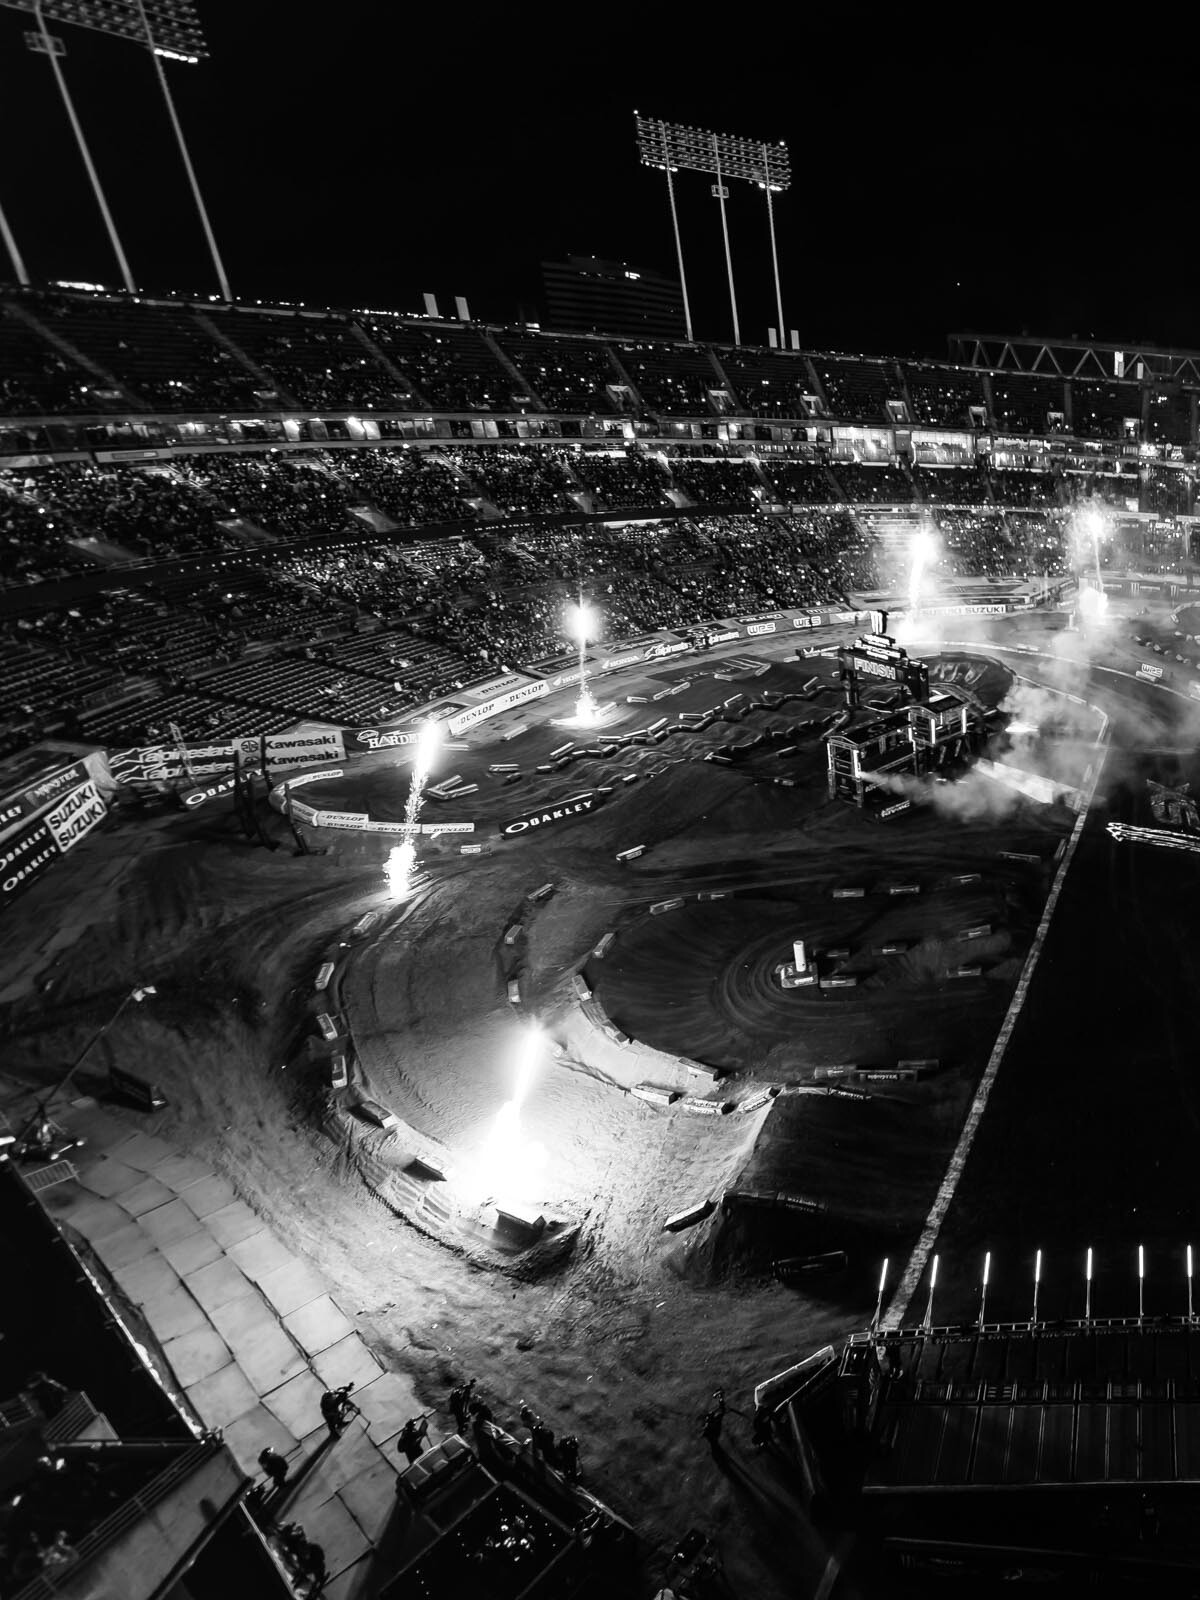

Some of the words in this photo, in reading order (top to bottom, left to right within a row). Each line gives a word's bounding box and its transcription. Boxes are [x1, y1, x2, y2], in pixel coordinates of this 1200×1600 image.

[965, 606, 1005, 615] SUZUKI
[854, 657, 896, 680] FINISH
[481, 676, 520, 695] DUNLOP
[509, 683, 544, 703] DUNLOP
[459, 703, 495, 725] DUNLOP
[265, 734, 337, 751] Kawasaki
[267, 750, 339, 768] Kawasaki
[50, 785, 95, 830] SUZUKI
[326, 813, 366, 822] DUNLOP
[530, 800, 593, 826] OAKLEY
[58, 801, 105, 847] SUZUKI
[6, 826, 47, 862] OAKLEY
[17, 845, 57, 880] OAKLEY
